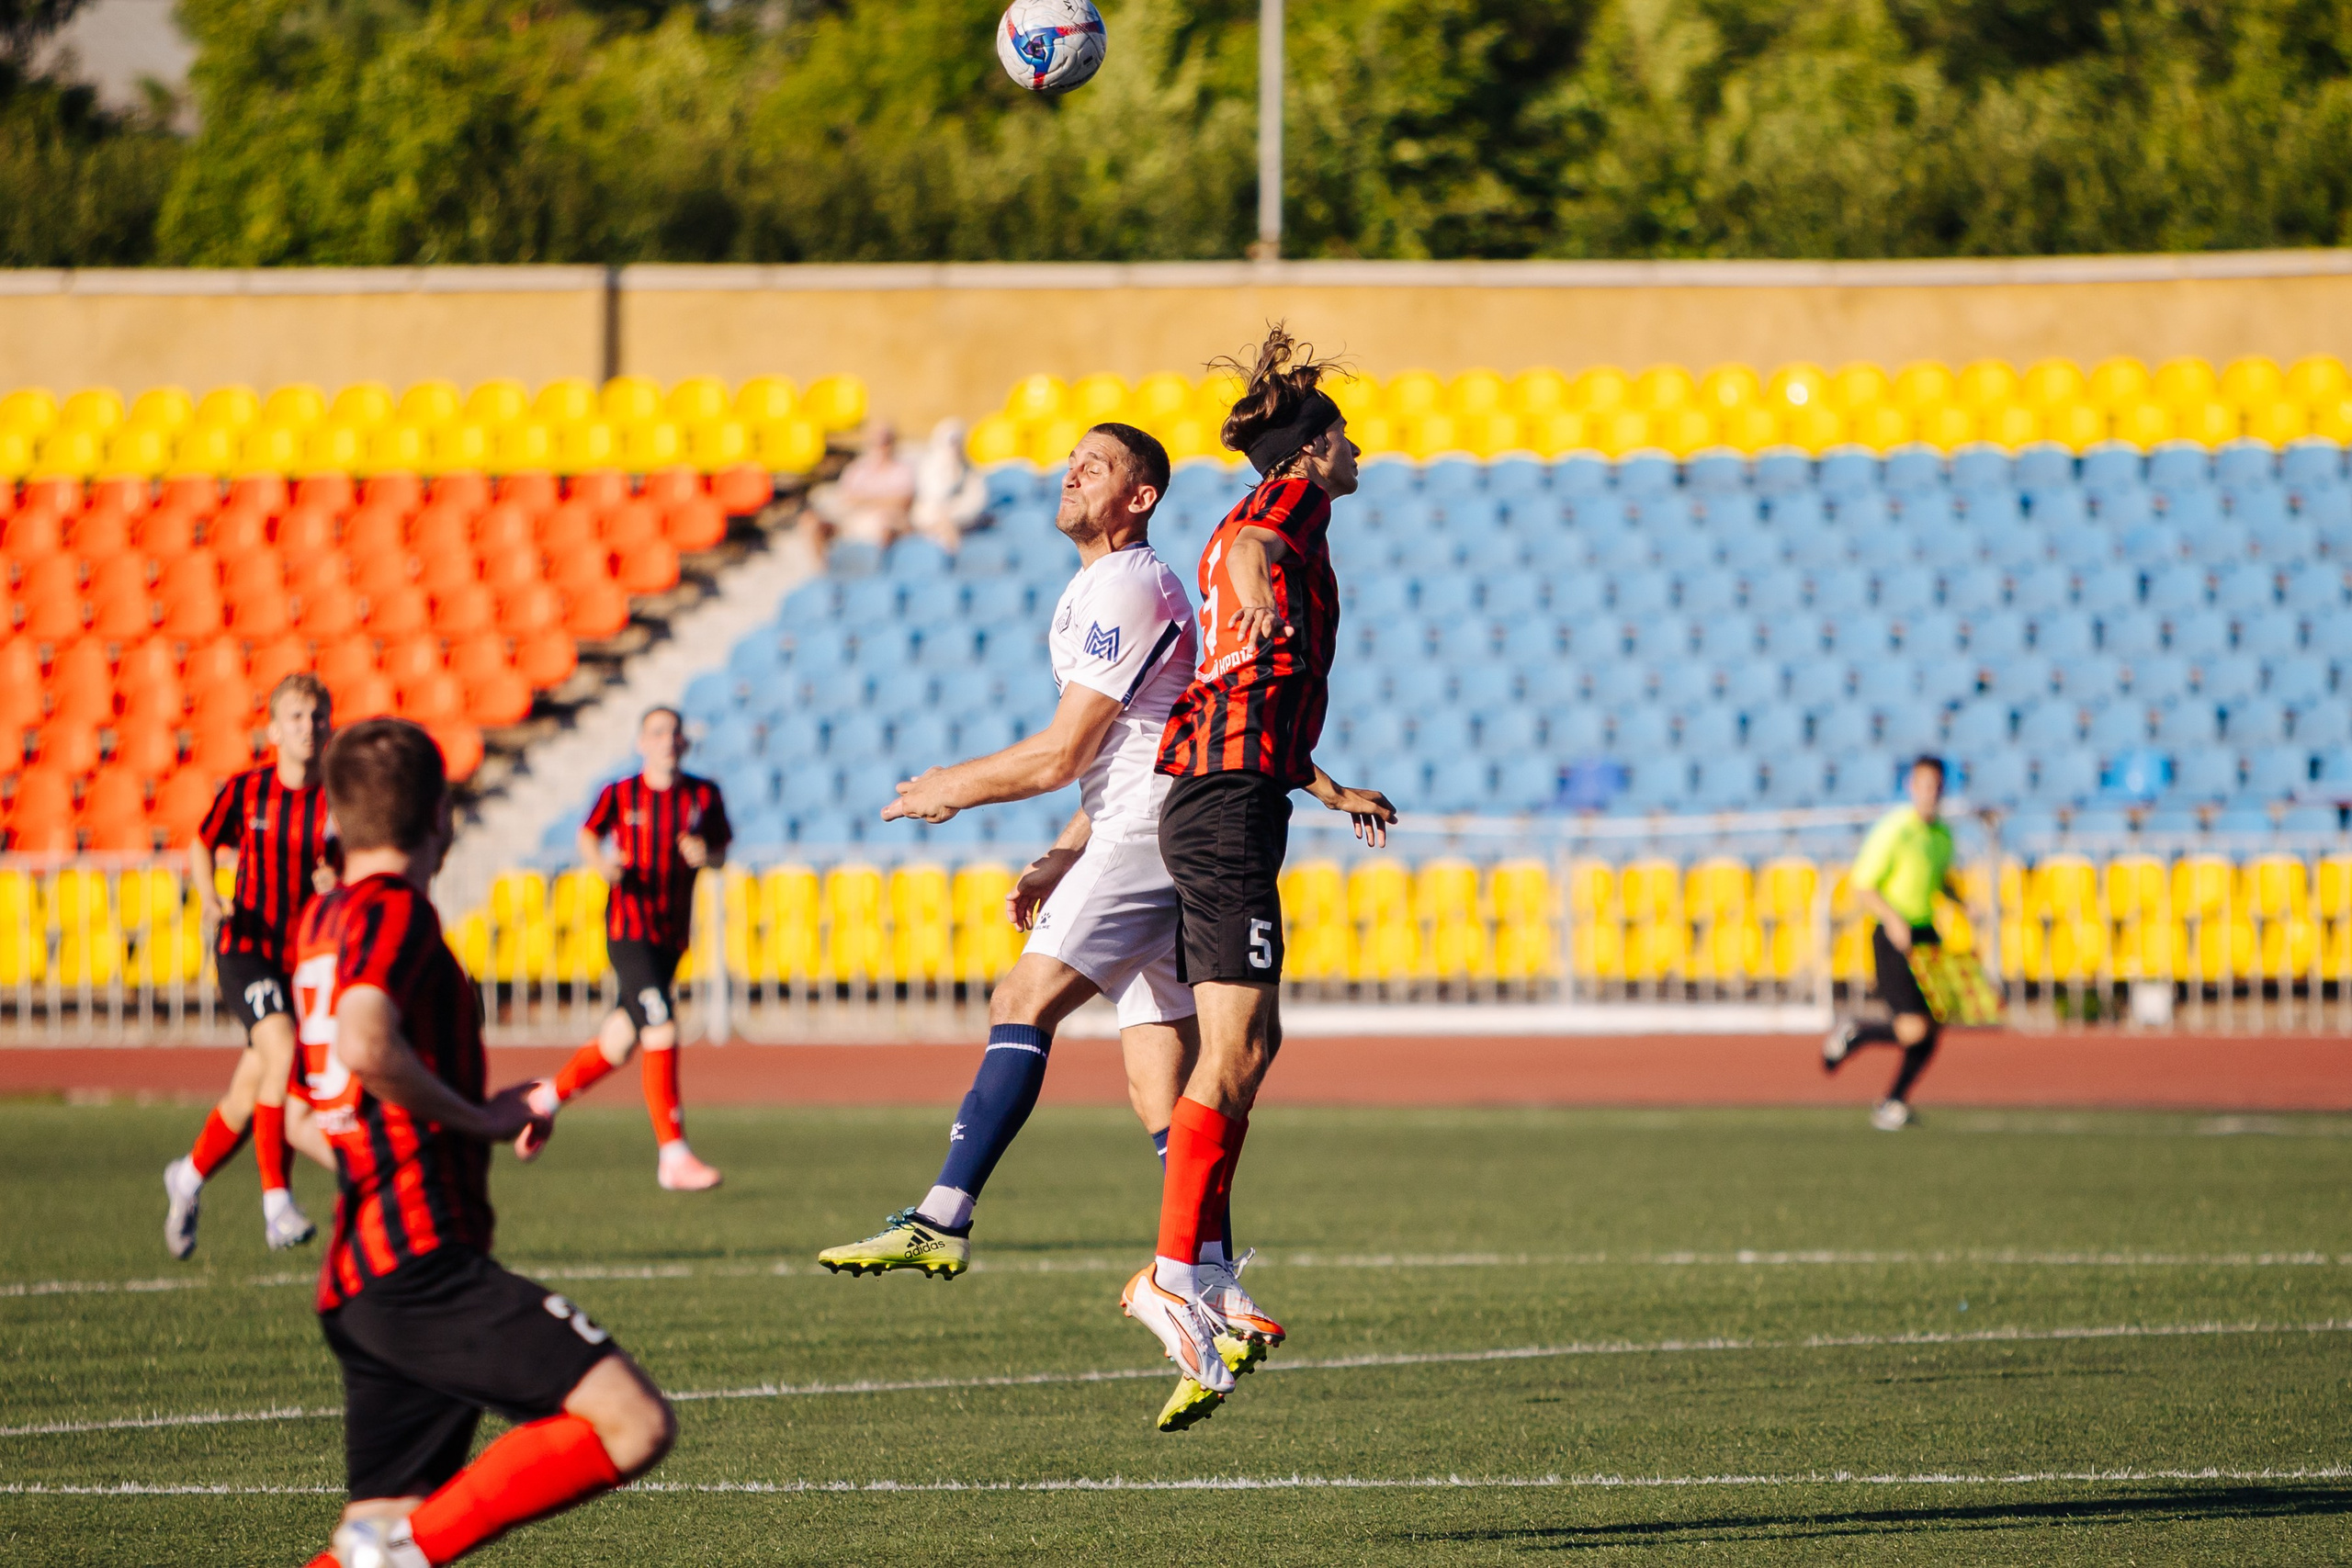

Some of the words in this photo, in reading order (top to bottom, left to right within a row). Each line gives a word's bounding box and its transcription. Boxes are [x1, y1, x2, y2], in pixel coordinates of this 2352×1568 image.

[1250, 919, 1272, 968] 5
[244, 977, 284, 1021] 77
[904, 1240, 945, 1259] adidas
